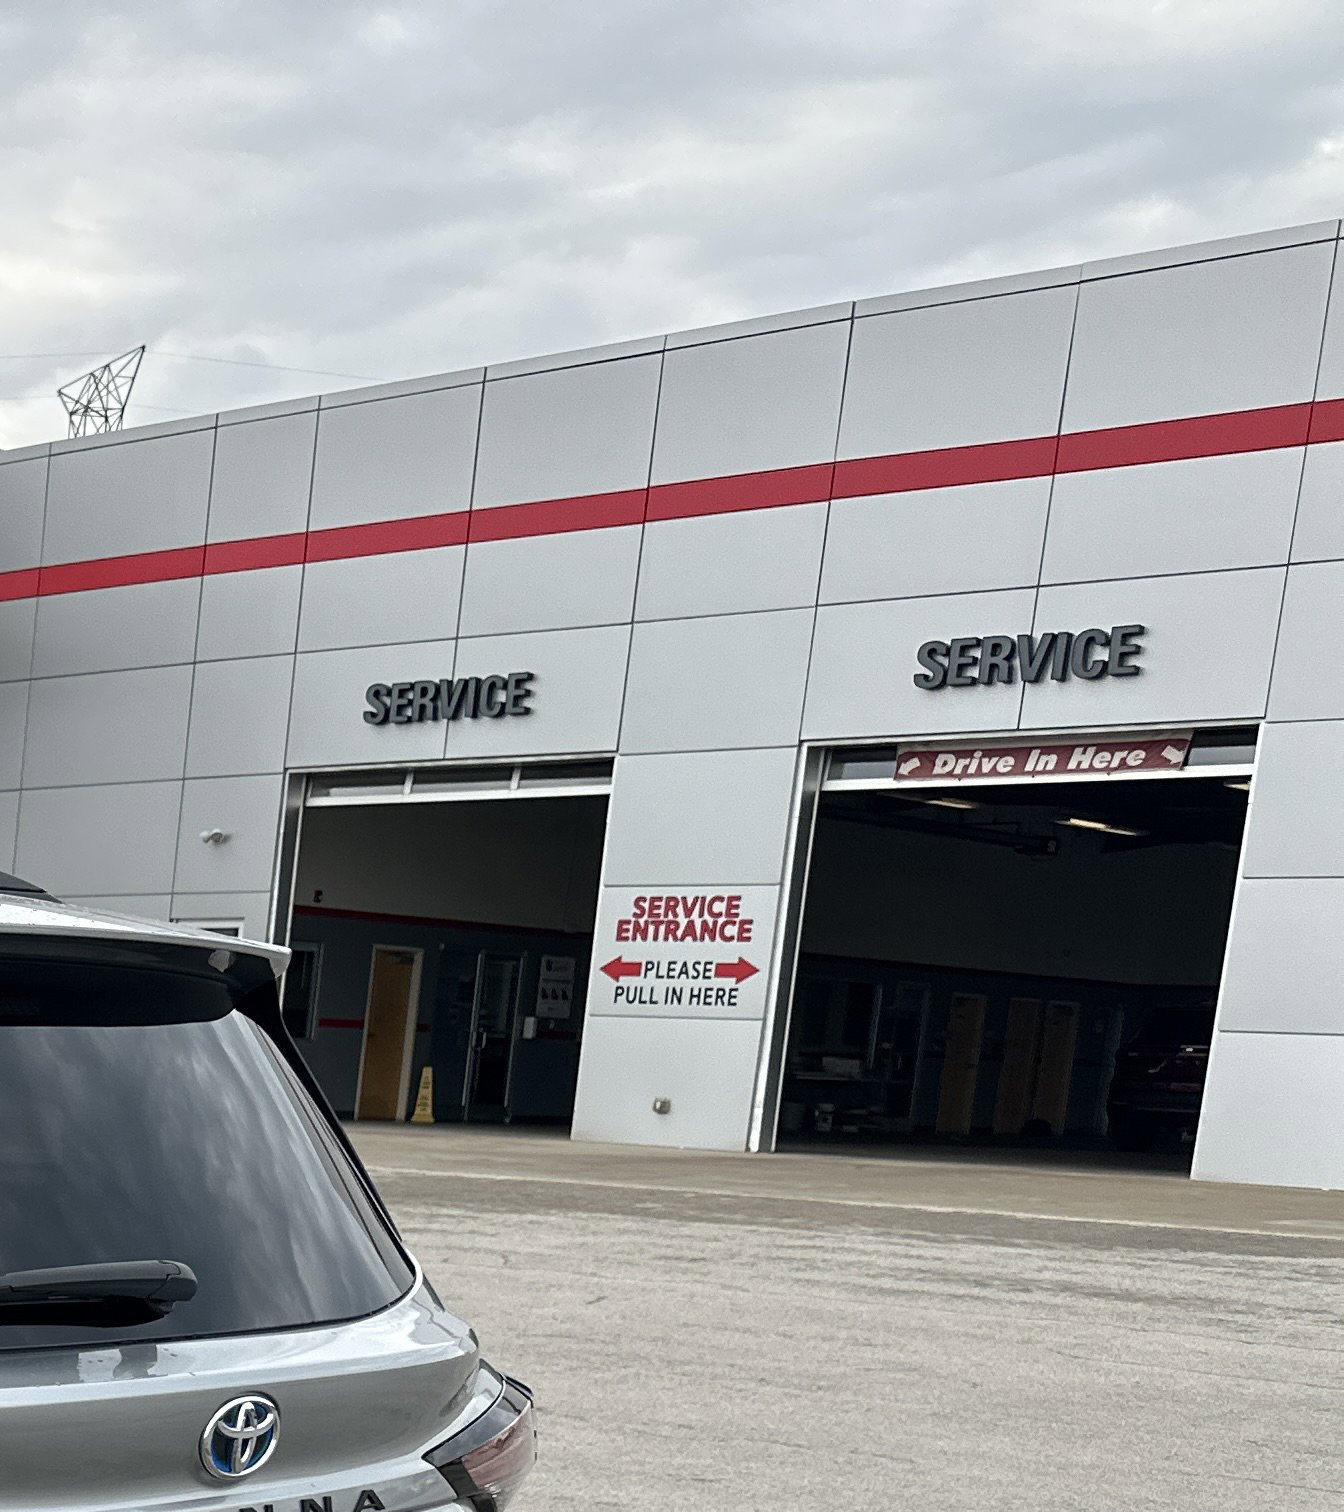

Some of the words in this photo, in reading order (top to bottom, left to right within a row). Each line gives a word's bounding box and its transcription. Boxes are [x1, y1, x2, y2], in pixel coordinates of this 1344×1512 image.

[912, 624, 1145, 690] SERVICE
[363, 671, 534, 725] SERVICE
[932, 751, 1015, 775] Drive
[1024, 749, 1057, 772] In
[1067, 746, 1146, 770] Here
[632, 895, 742, 919] SERVICE
[615, 919, 754, 942] ENTRANCE
[643, 960, 714, 979] PLEASE
[613, 985, 659, 1004] PULL
[664, 986, 683, 1006] IN
[688, 987, 739, 1006] HERE
